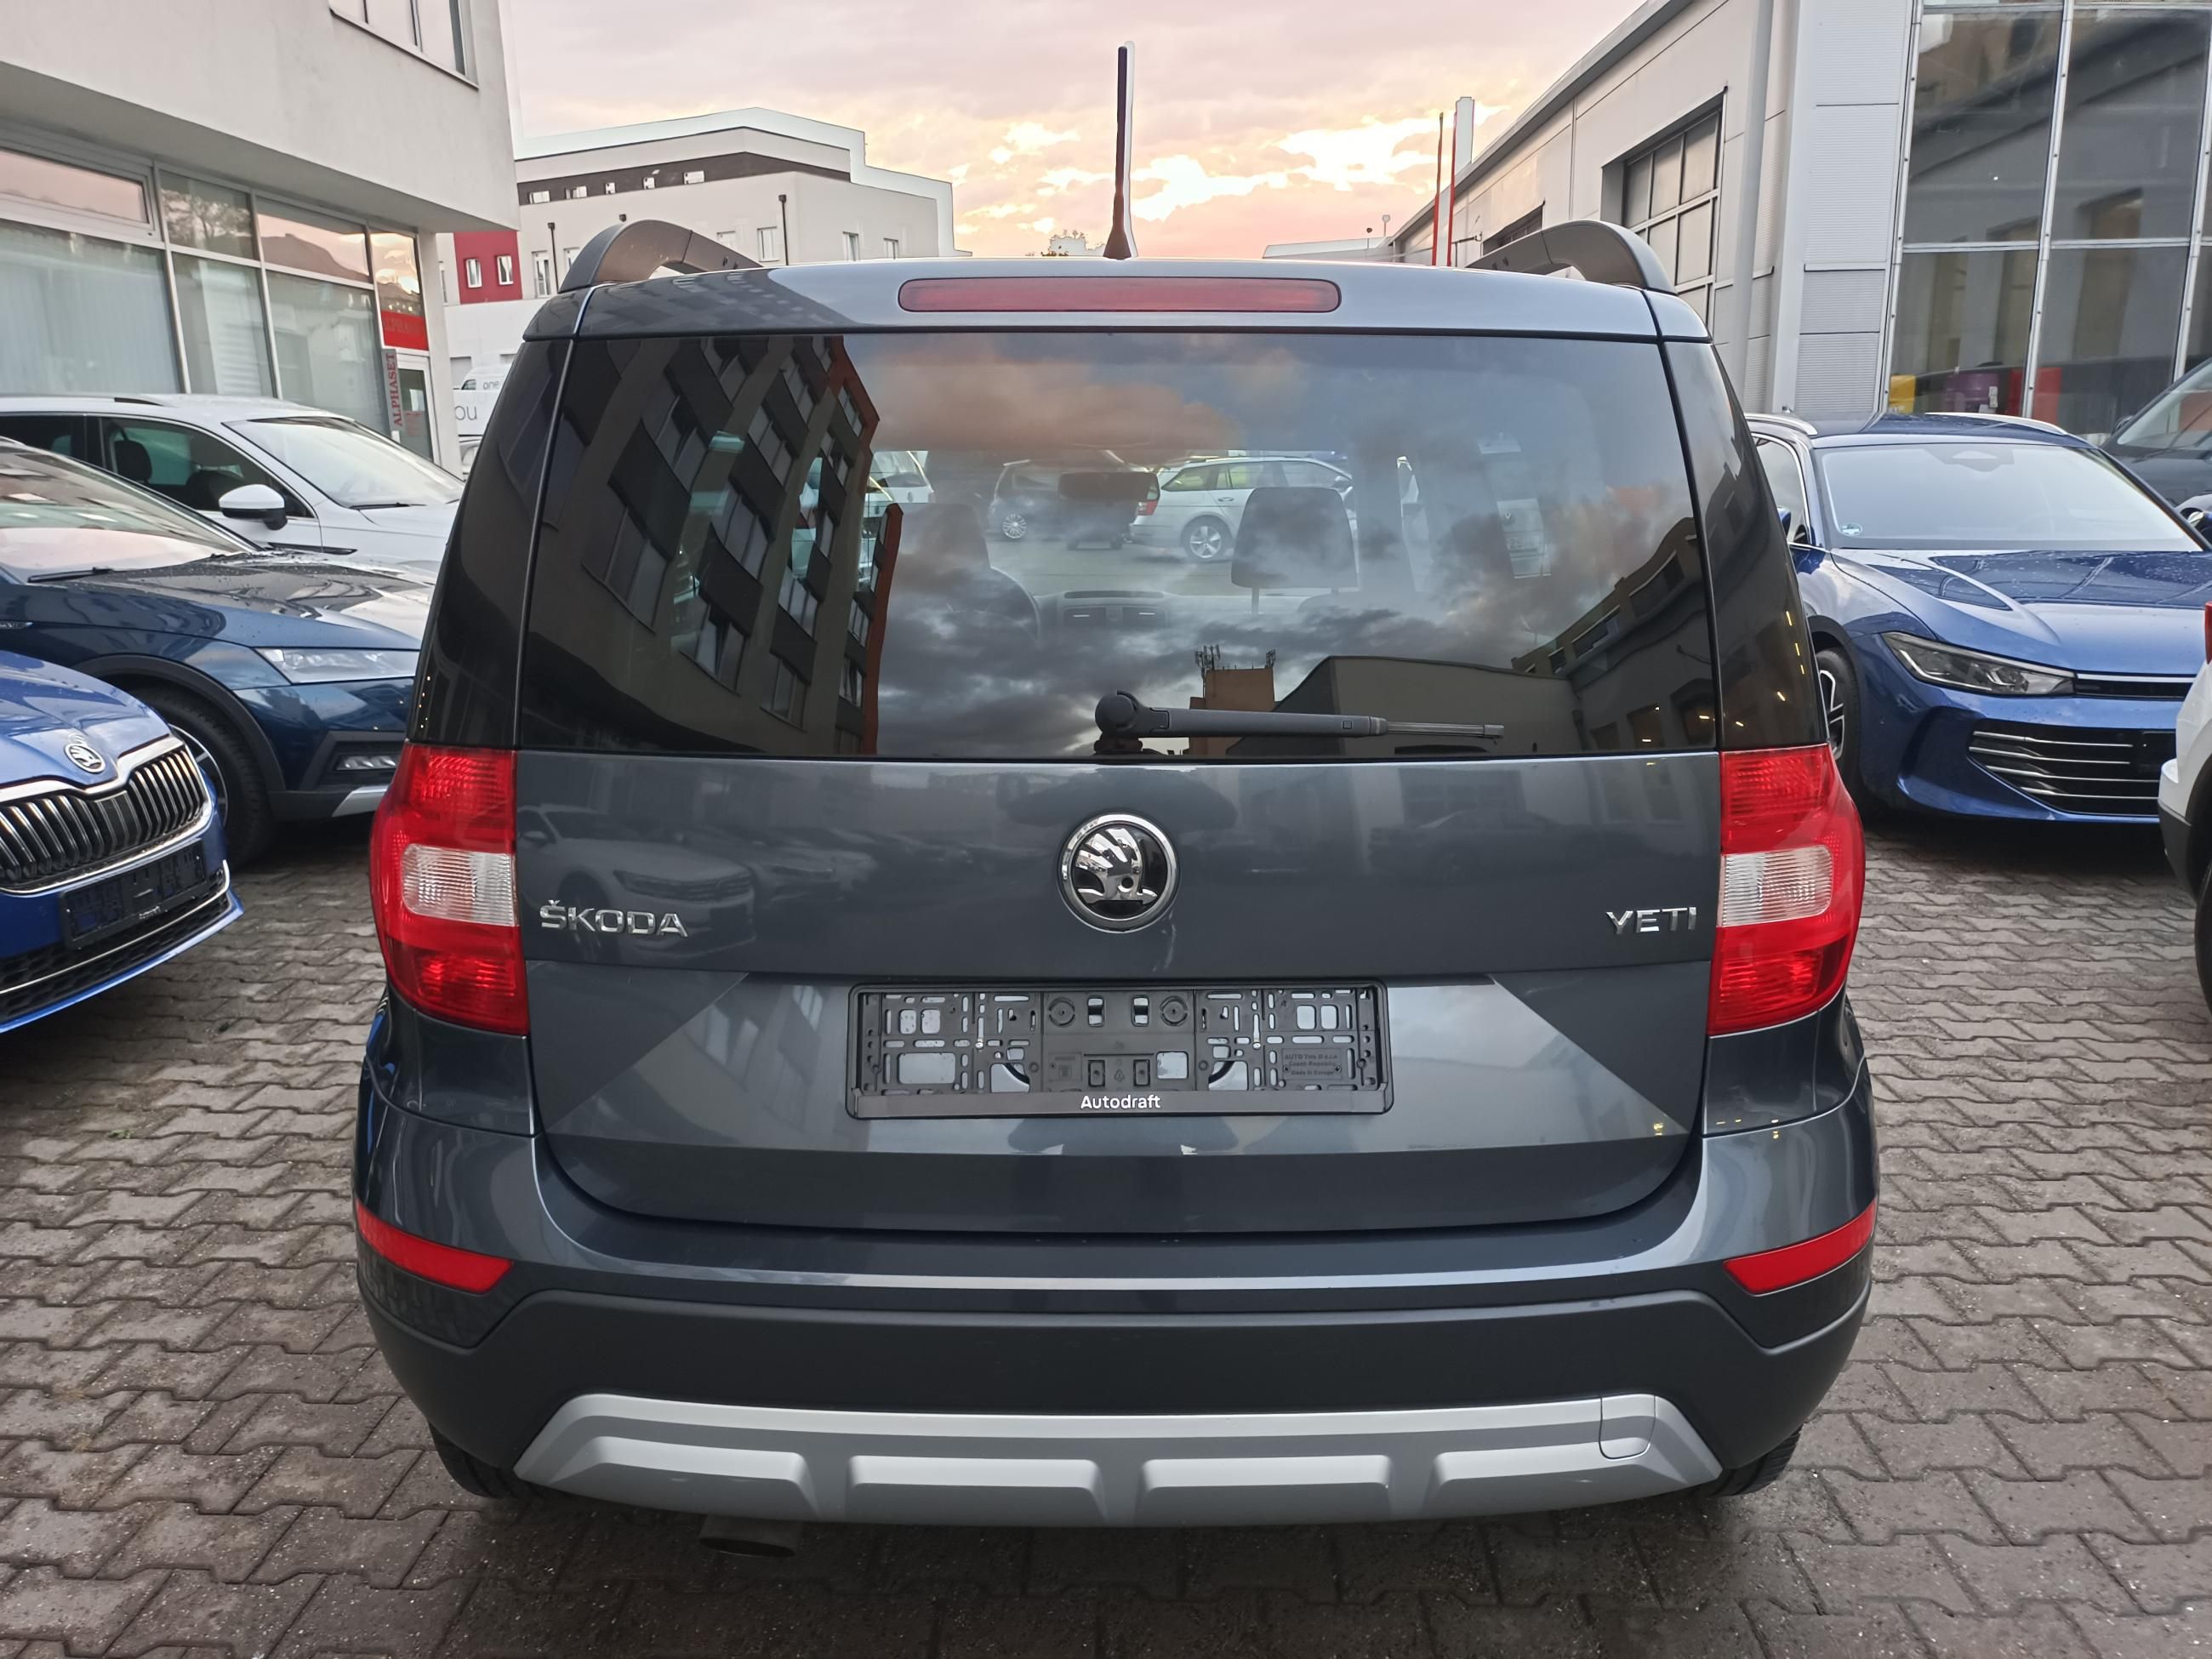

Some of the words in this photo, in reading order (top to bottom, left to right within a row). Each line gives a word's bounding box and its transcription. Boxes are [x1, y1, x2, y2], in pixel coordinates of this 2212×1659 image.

[386, 353, 402, 426] ALPHASET
[539, 899, 688, 938] ŠKODA
[1605, 906, 1697, 935] YETI
[1080, 1094, 1161, 1109] Autodraft
